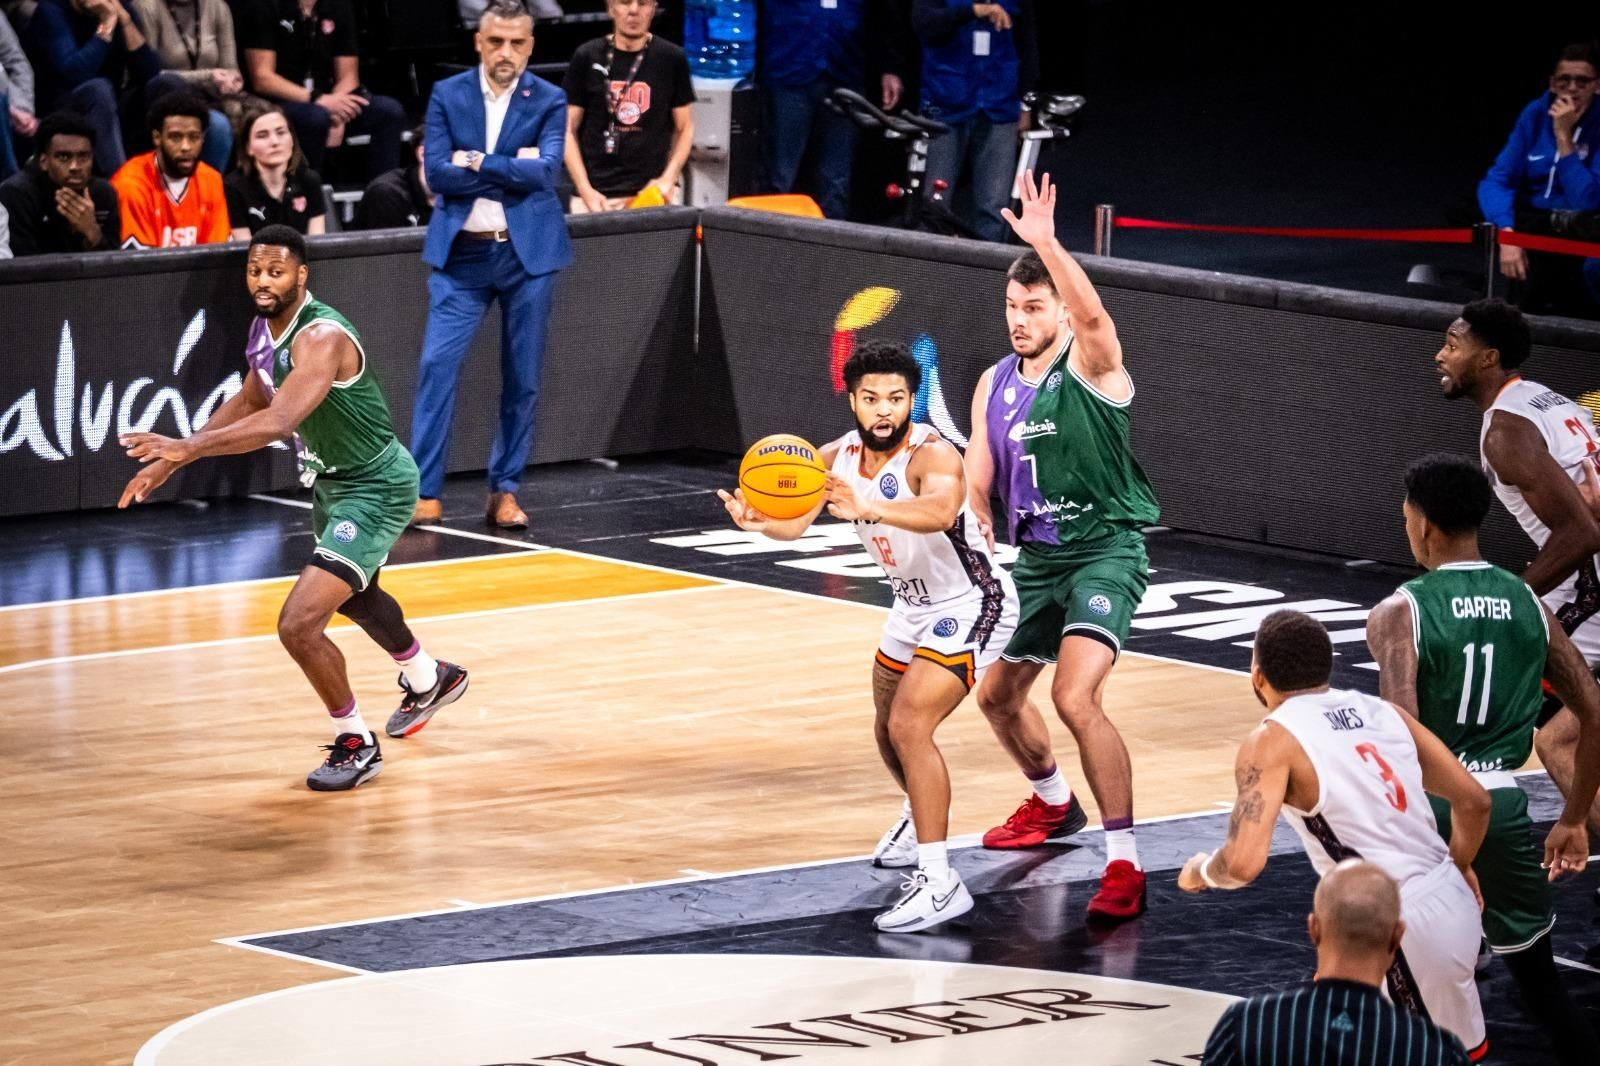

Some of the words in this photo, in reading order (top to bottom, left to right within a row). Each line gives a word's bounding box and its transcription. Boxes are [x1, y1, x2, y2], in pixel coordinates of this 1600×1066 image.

[758, 444, 815, 462] Wilson
[777, 479, 797, 489] FIBA
[1019, 454, 1038, 488] 7
[871, 535, 897, 568] 12
[1451, 595, 1512, 620] CARTER
[1456, 642, 1494, 726] 11
[1355, 742, 1408, 813] 3
